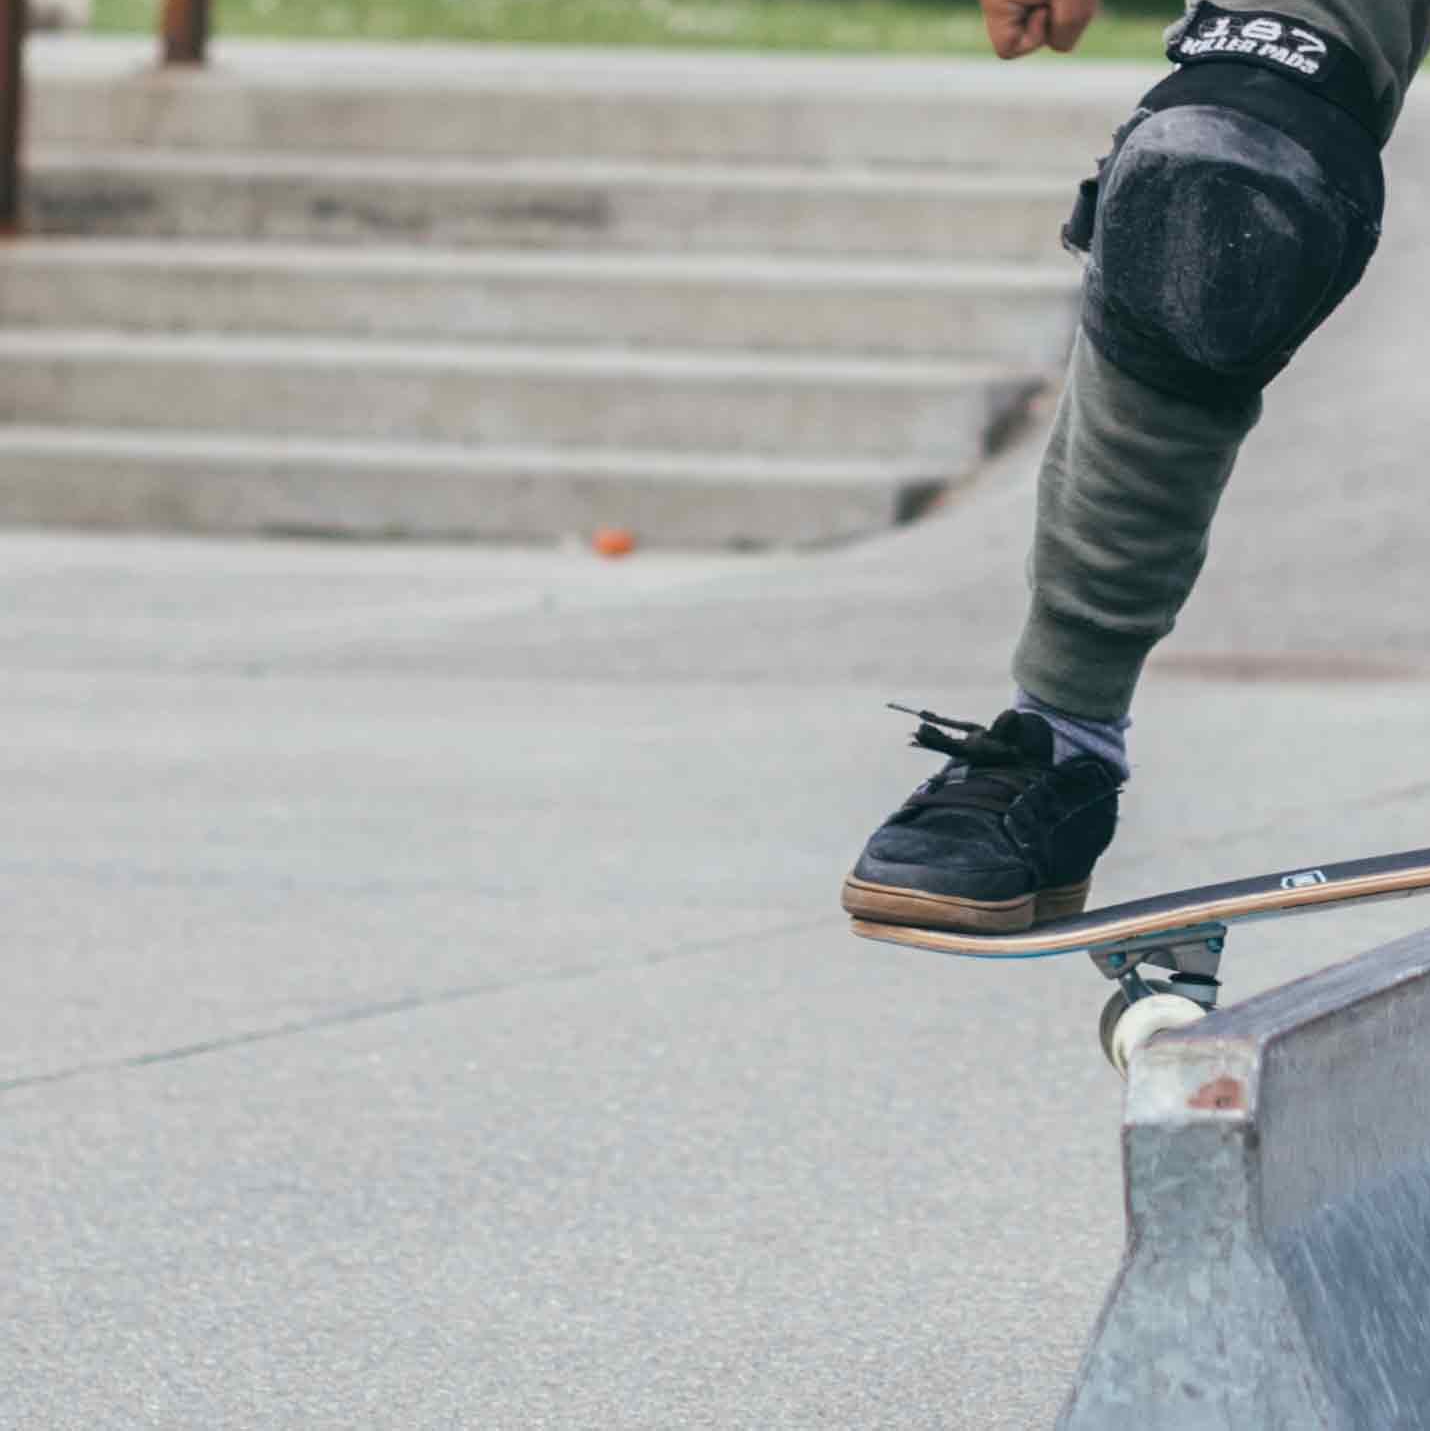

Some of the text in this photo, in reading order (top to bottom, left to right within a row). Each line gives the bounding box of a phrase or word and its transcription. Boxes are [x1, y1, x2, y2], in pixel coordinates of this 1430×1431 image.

[1202, 17, 1327, 54] 187
[1180, 36, 1320, 74] KILLER PADS
